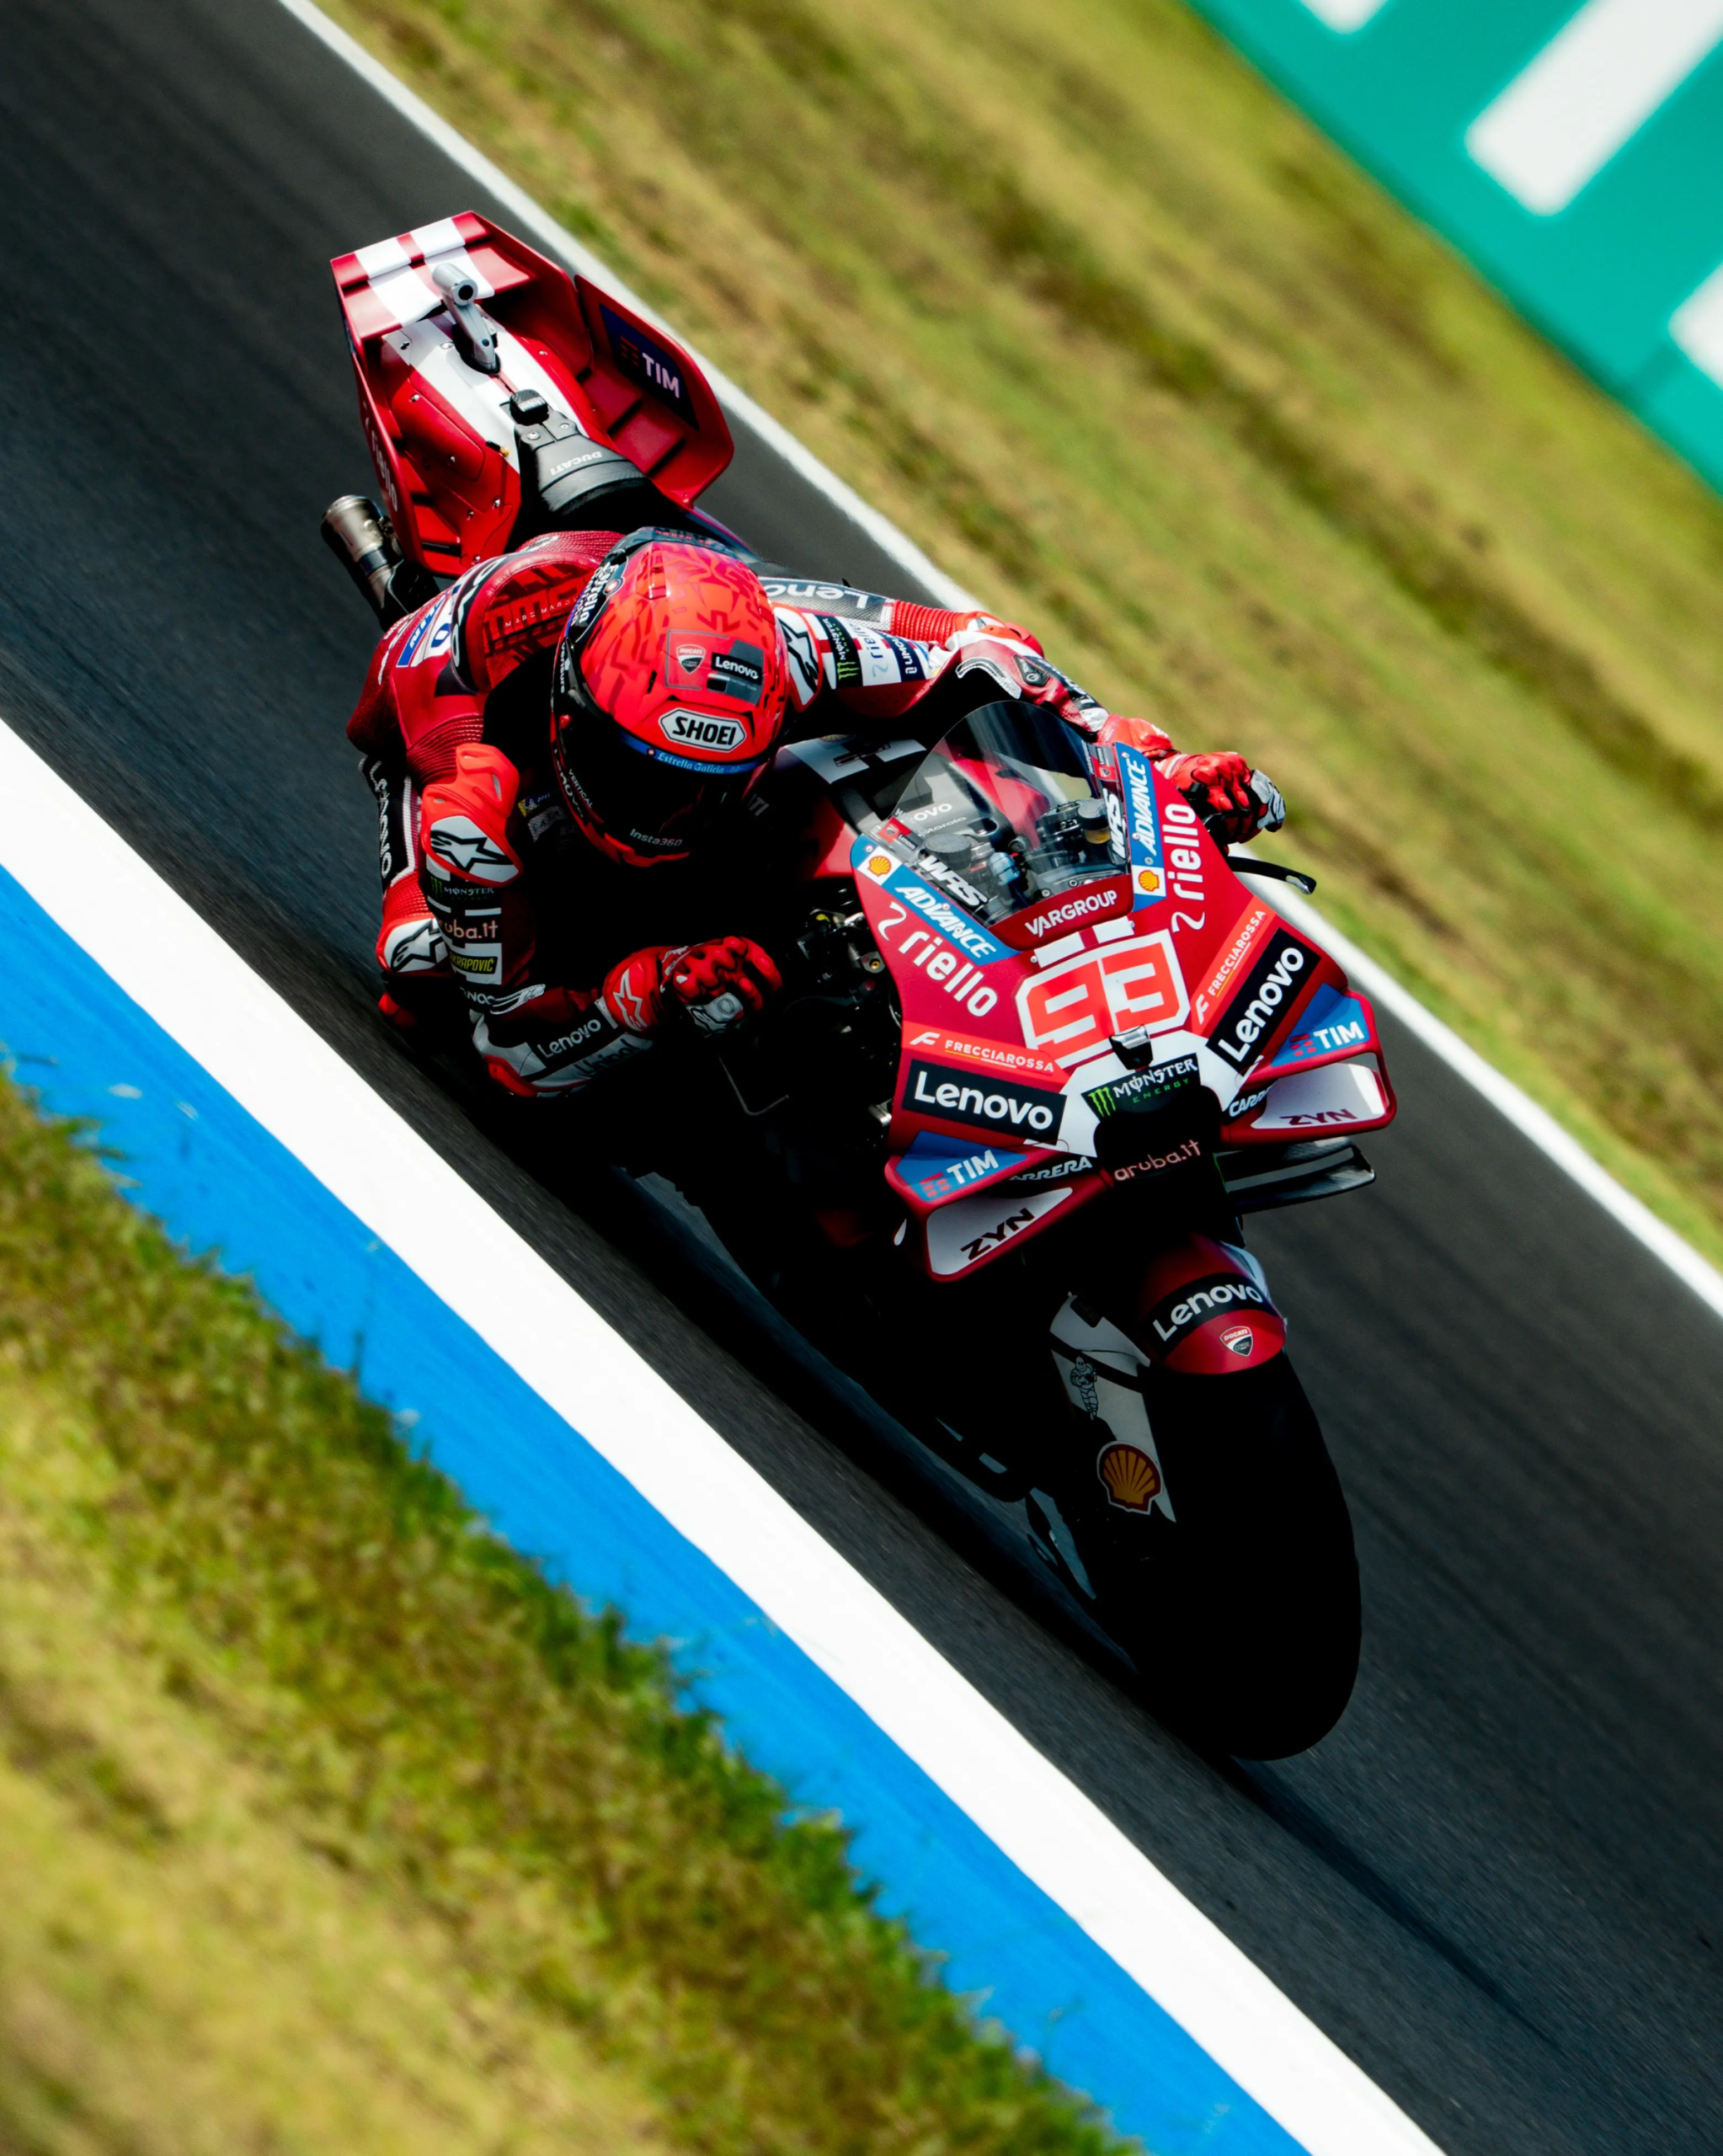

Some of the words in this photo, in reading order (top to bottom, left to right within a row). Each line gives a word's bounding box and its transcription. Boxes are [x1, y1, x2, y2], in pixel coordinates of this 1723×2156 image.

[642, 352, 680, 399] TIM
[550, 451, 603, 476] DUCATI
[763, 584, 869, 609] Leno
[822, 617, 847, 661] MONSTER
[715, 656, 759, 680] Lenovo
[673, 716, 737, 745] SHOEI
[658, 751, 692, 770] Estrella
[694, 761, 724, 775] Galicia
[1103, 787, 1126, 859] WRS
[1126, 759, 1157, 857] ADVANCE
[628, 827, 684, 846] Insta360
[898, 834, 917, 851] Lenovo
[1162, 803, 1204, 900] riello
[444, 886, 495, 897] MONSTER
[918, 855, 988, 906] WRS
[894, 887, 997, 958] ADVANCE
[1025, 890, 1117, 937] VARGROUP
[898, 931, 998, 1017] riello
[1208, 910, 1266, 997] FRECCIAROSSA
[1026, 942, 1181, 1061] 93
[1219, 947, 1304, 1062] Lenovo
[537, 1018, 602, 1059] Lenovo
[945, 1039, 1054, 1073] FRECCIAROSSA
[1314, 1022, 1365, 1049] TIM
[1112, 1059, 1198, 1098] MONSTER
[1133, 1078, 1189, 1103] ENERGY
[915, 1070, 1054, 1130] Lenovo
[1279, 1108, 1358, 1127] ZYN
[946, 1149, 1000, 1184] TIM
[1114, 1139, 1201, 1181] aruba.it
[960, 1208, 1035, 1261] ZYN
[1152, 1283, 1263, 1342] Lenovo
[1224, 1328, 1249, 1342] DUCATI
